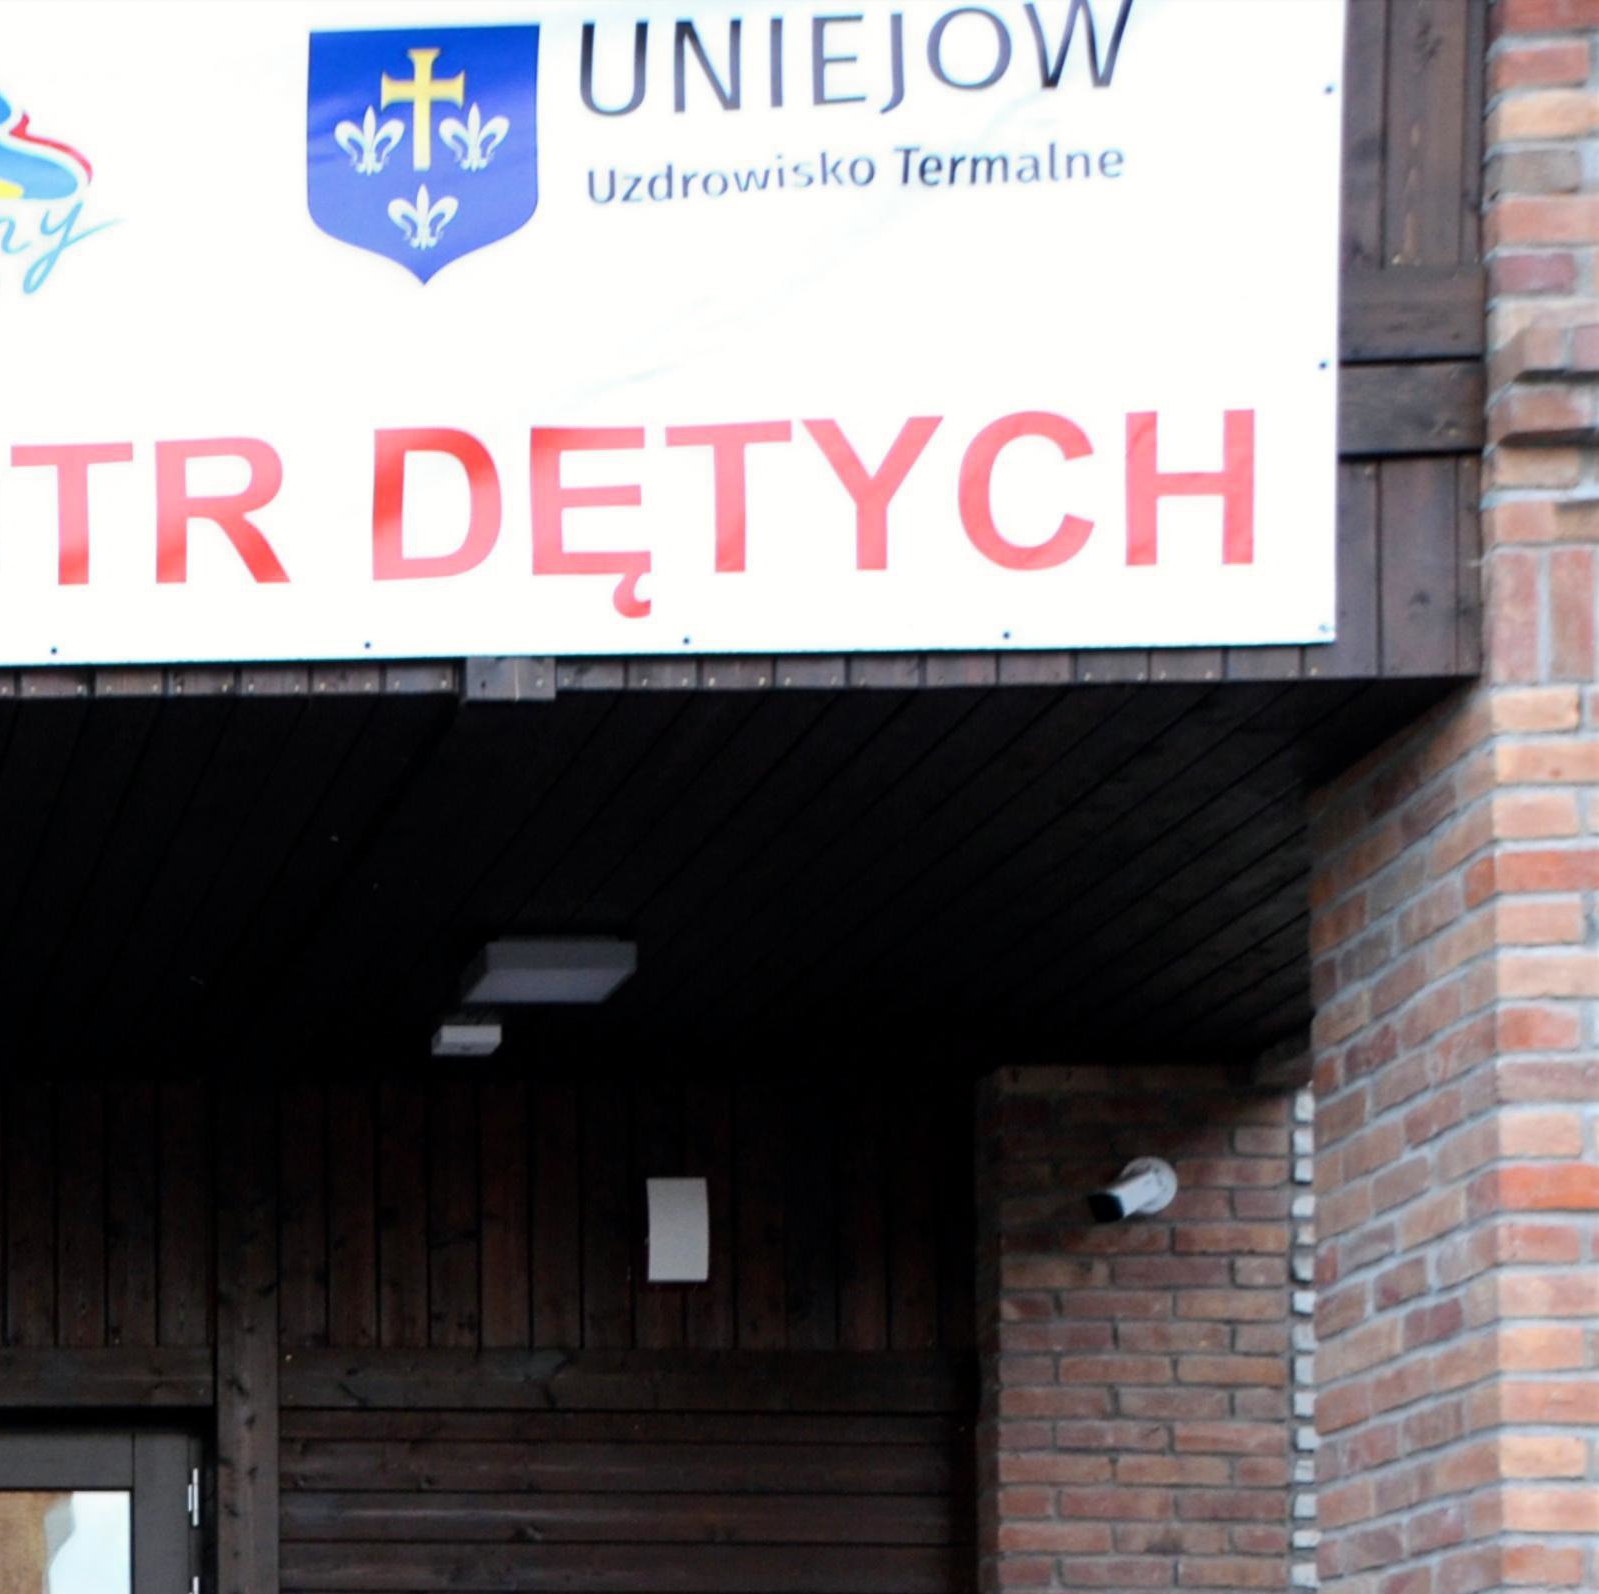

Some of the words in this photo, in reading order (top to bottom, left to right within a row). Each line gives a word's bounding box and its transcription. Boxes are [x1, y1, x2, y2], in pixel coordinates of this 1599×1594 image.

[587, 152, 877, 204] Uzdrowisko
[894, 142, 1126, 188] Termalne
[373, 410, 1255, 619] DĘTYCH
